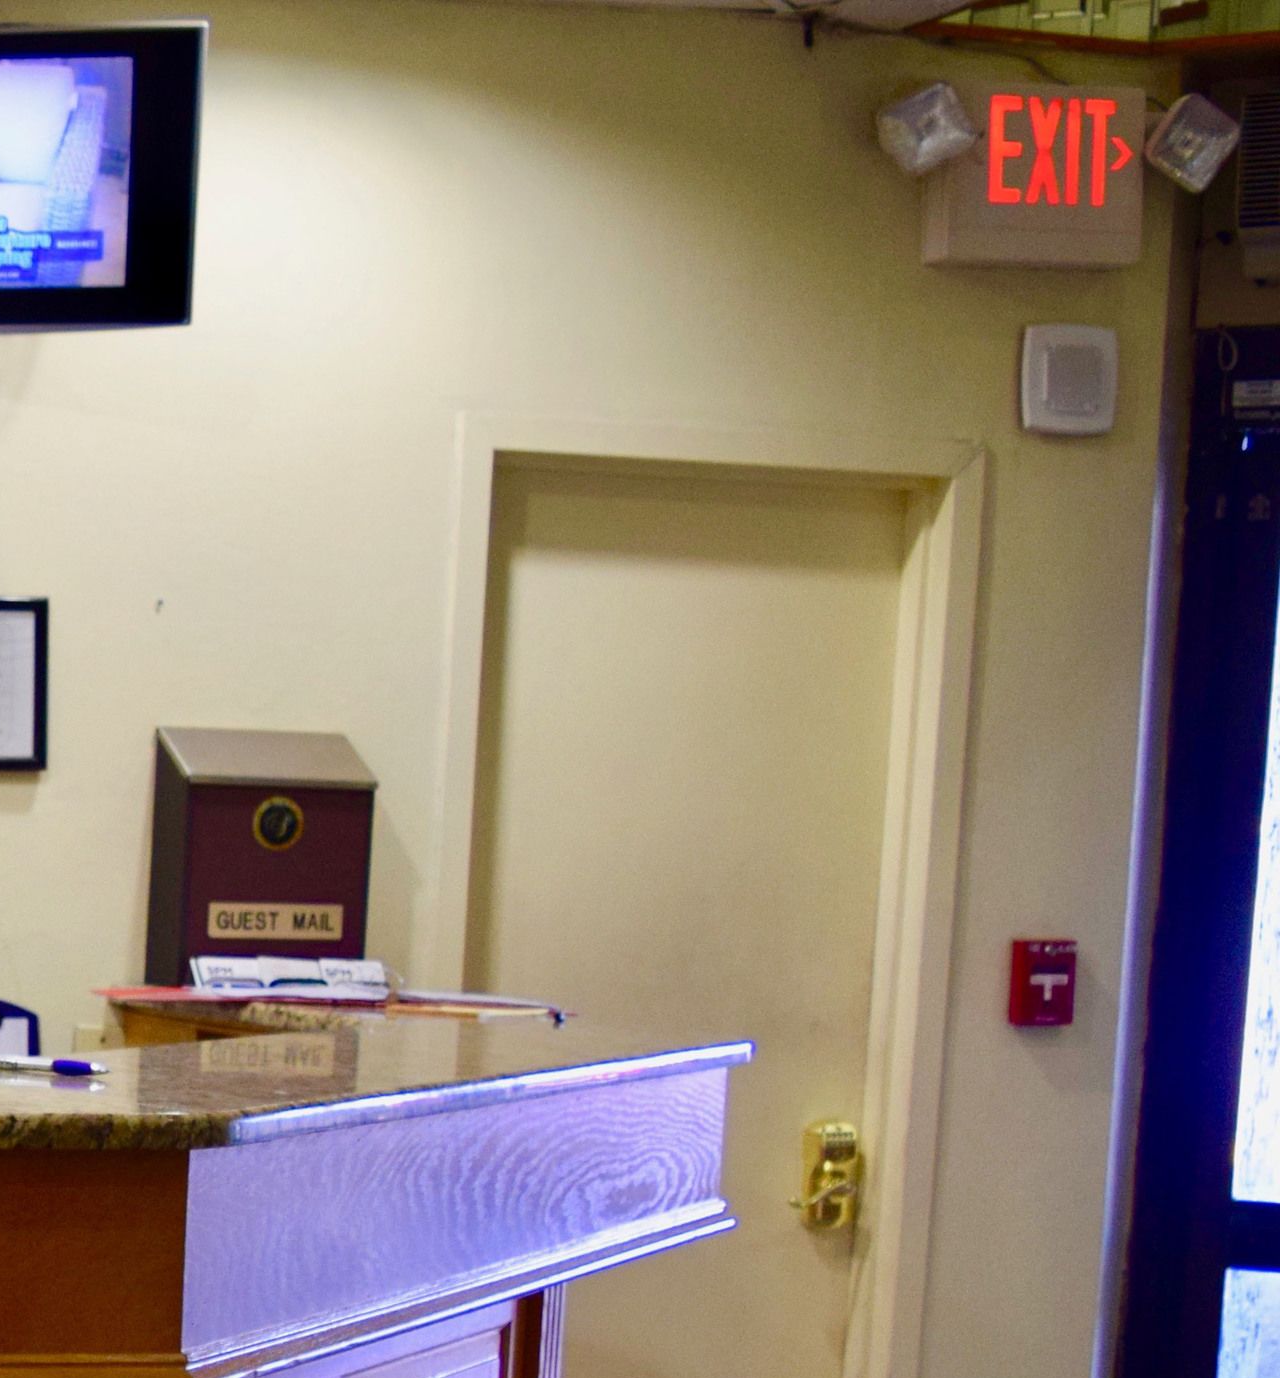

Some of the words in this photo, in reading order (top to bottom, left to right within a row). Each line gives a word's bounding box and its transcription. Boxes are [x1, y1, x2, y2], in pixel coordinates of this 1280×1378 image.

[987, 93, 1117, 207] EXIT
[216, 910, 279, 931] GUEST
[293, 911, 334, 932] MAIL
